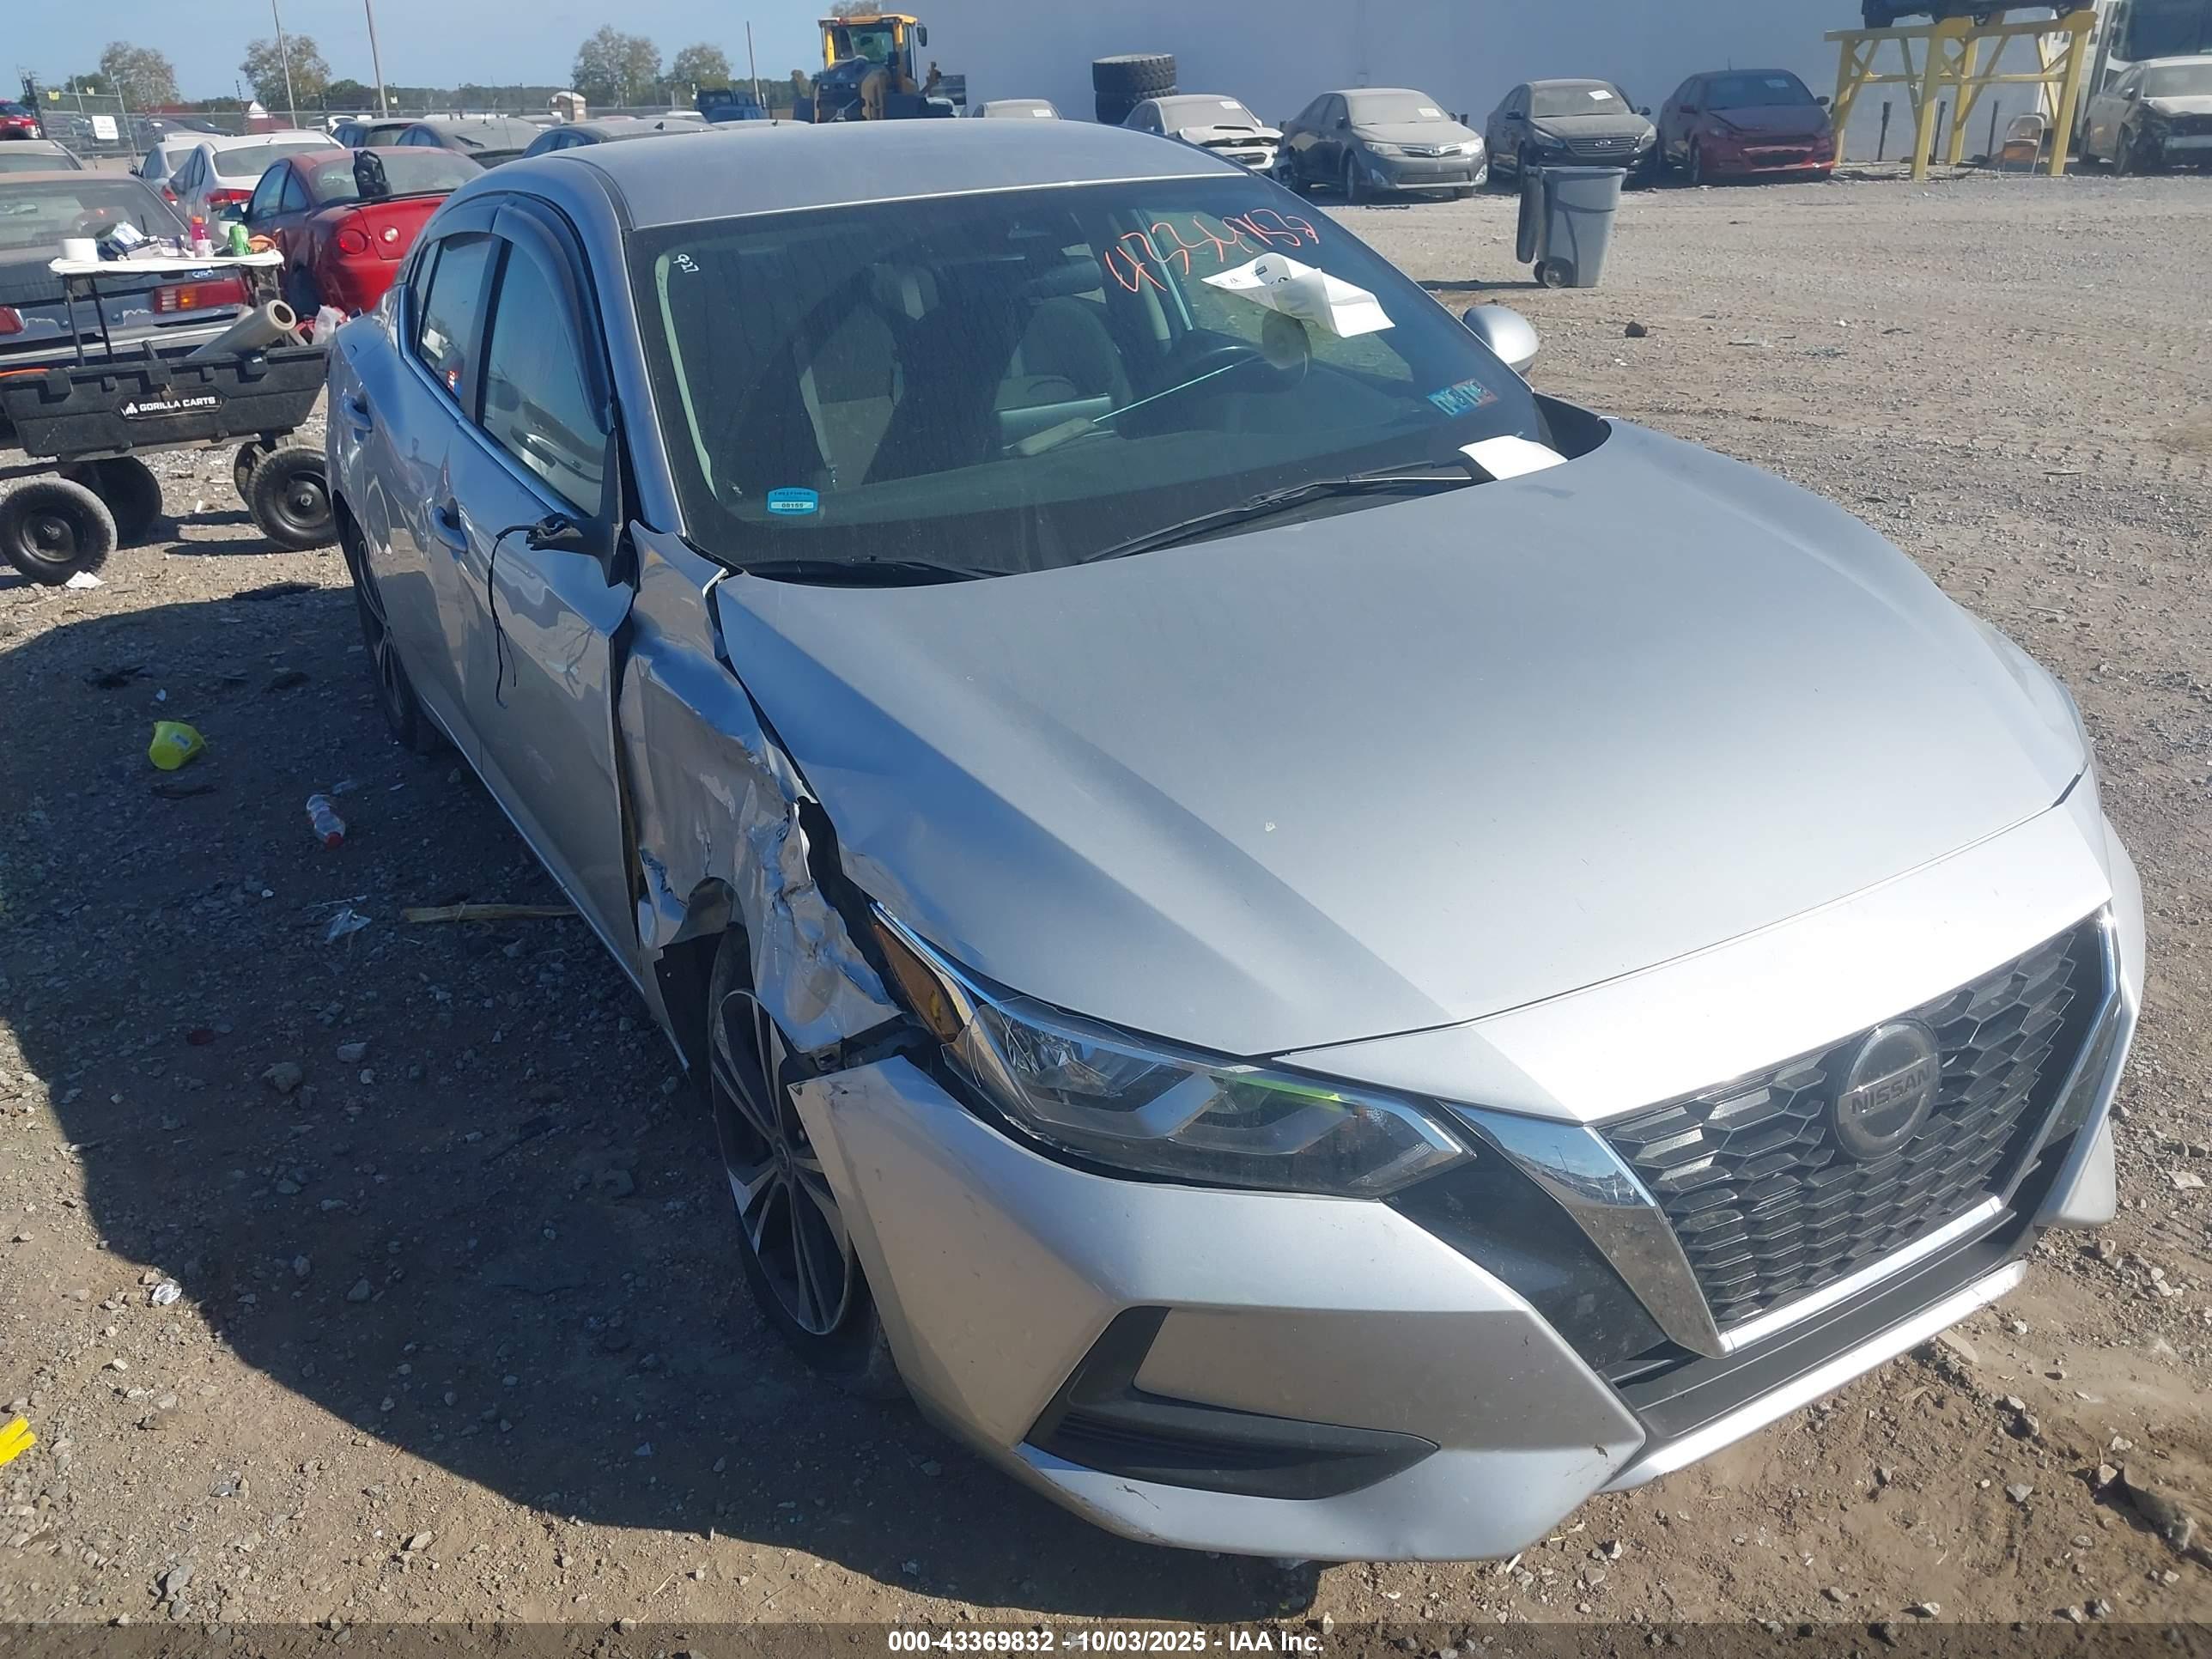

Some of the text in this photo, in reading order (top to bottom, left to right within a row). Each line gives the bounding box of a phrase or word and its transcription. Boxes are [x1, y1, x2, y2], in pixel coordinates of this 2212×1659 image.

[139, 397, 216, 412] GORILLA CARTS
[1850, 1064, 1931, 1115] NISSAN
